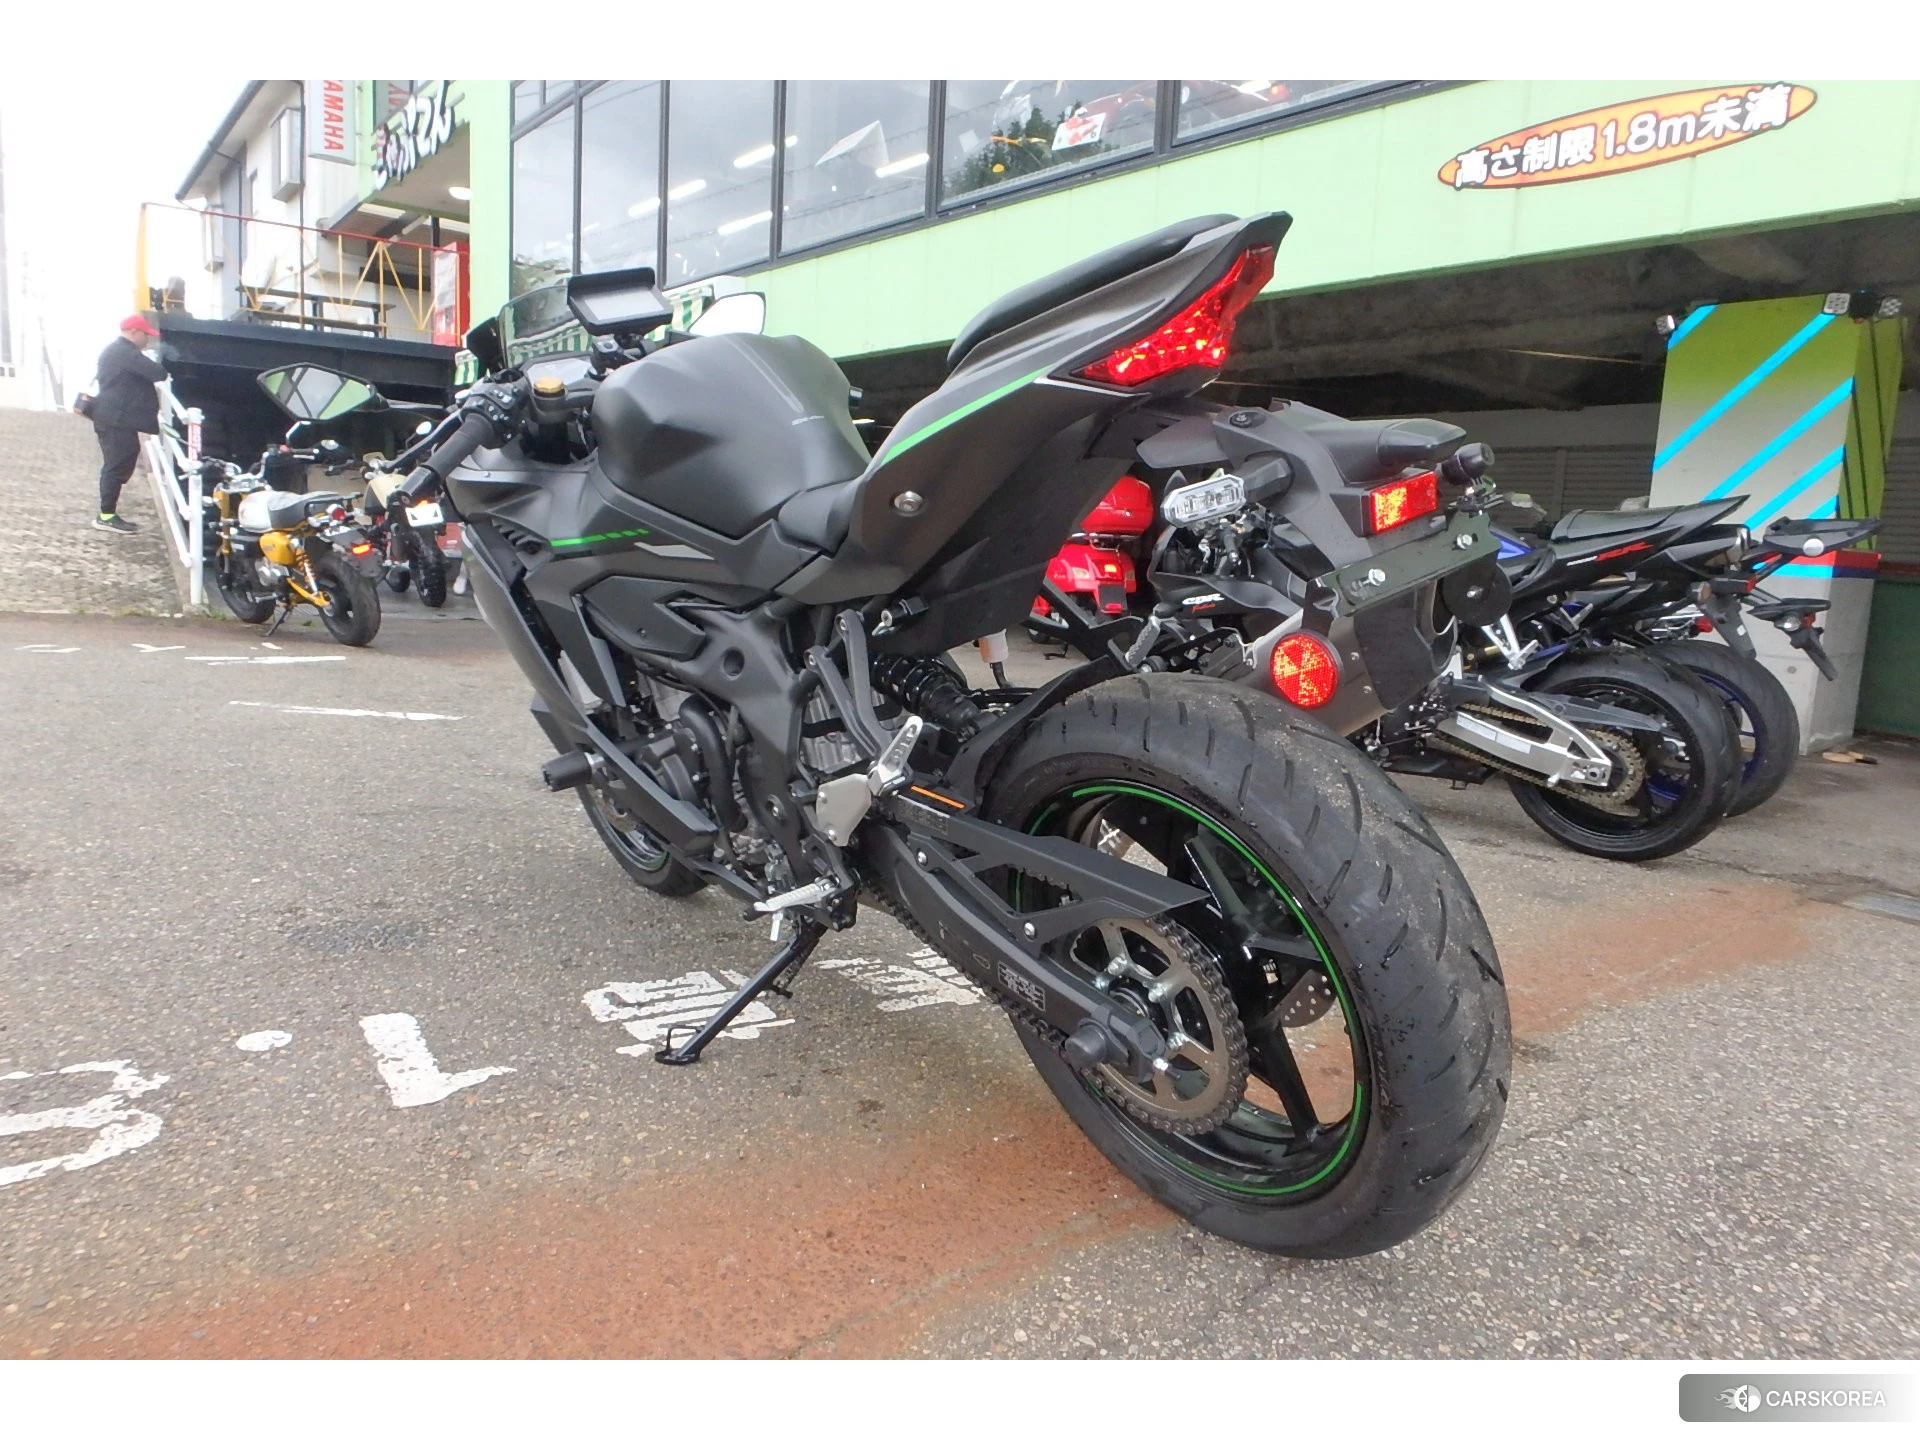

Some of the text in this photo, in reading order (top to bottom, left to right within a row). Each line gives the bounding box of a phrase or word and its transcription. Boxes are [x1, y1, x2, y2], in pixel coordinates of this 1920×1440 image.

[324, 80, 344, 151] AMAHA
[1455, 83, 1790, 187] 高さ制限1.8m未満
